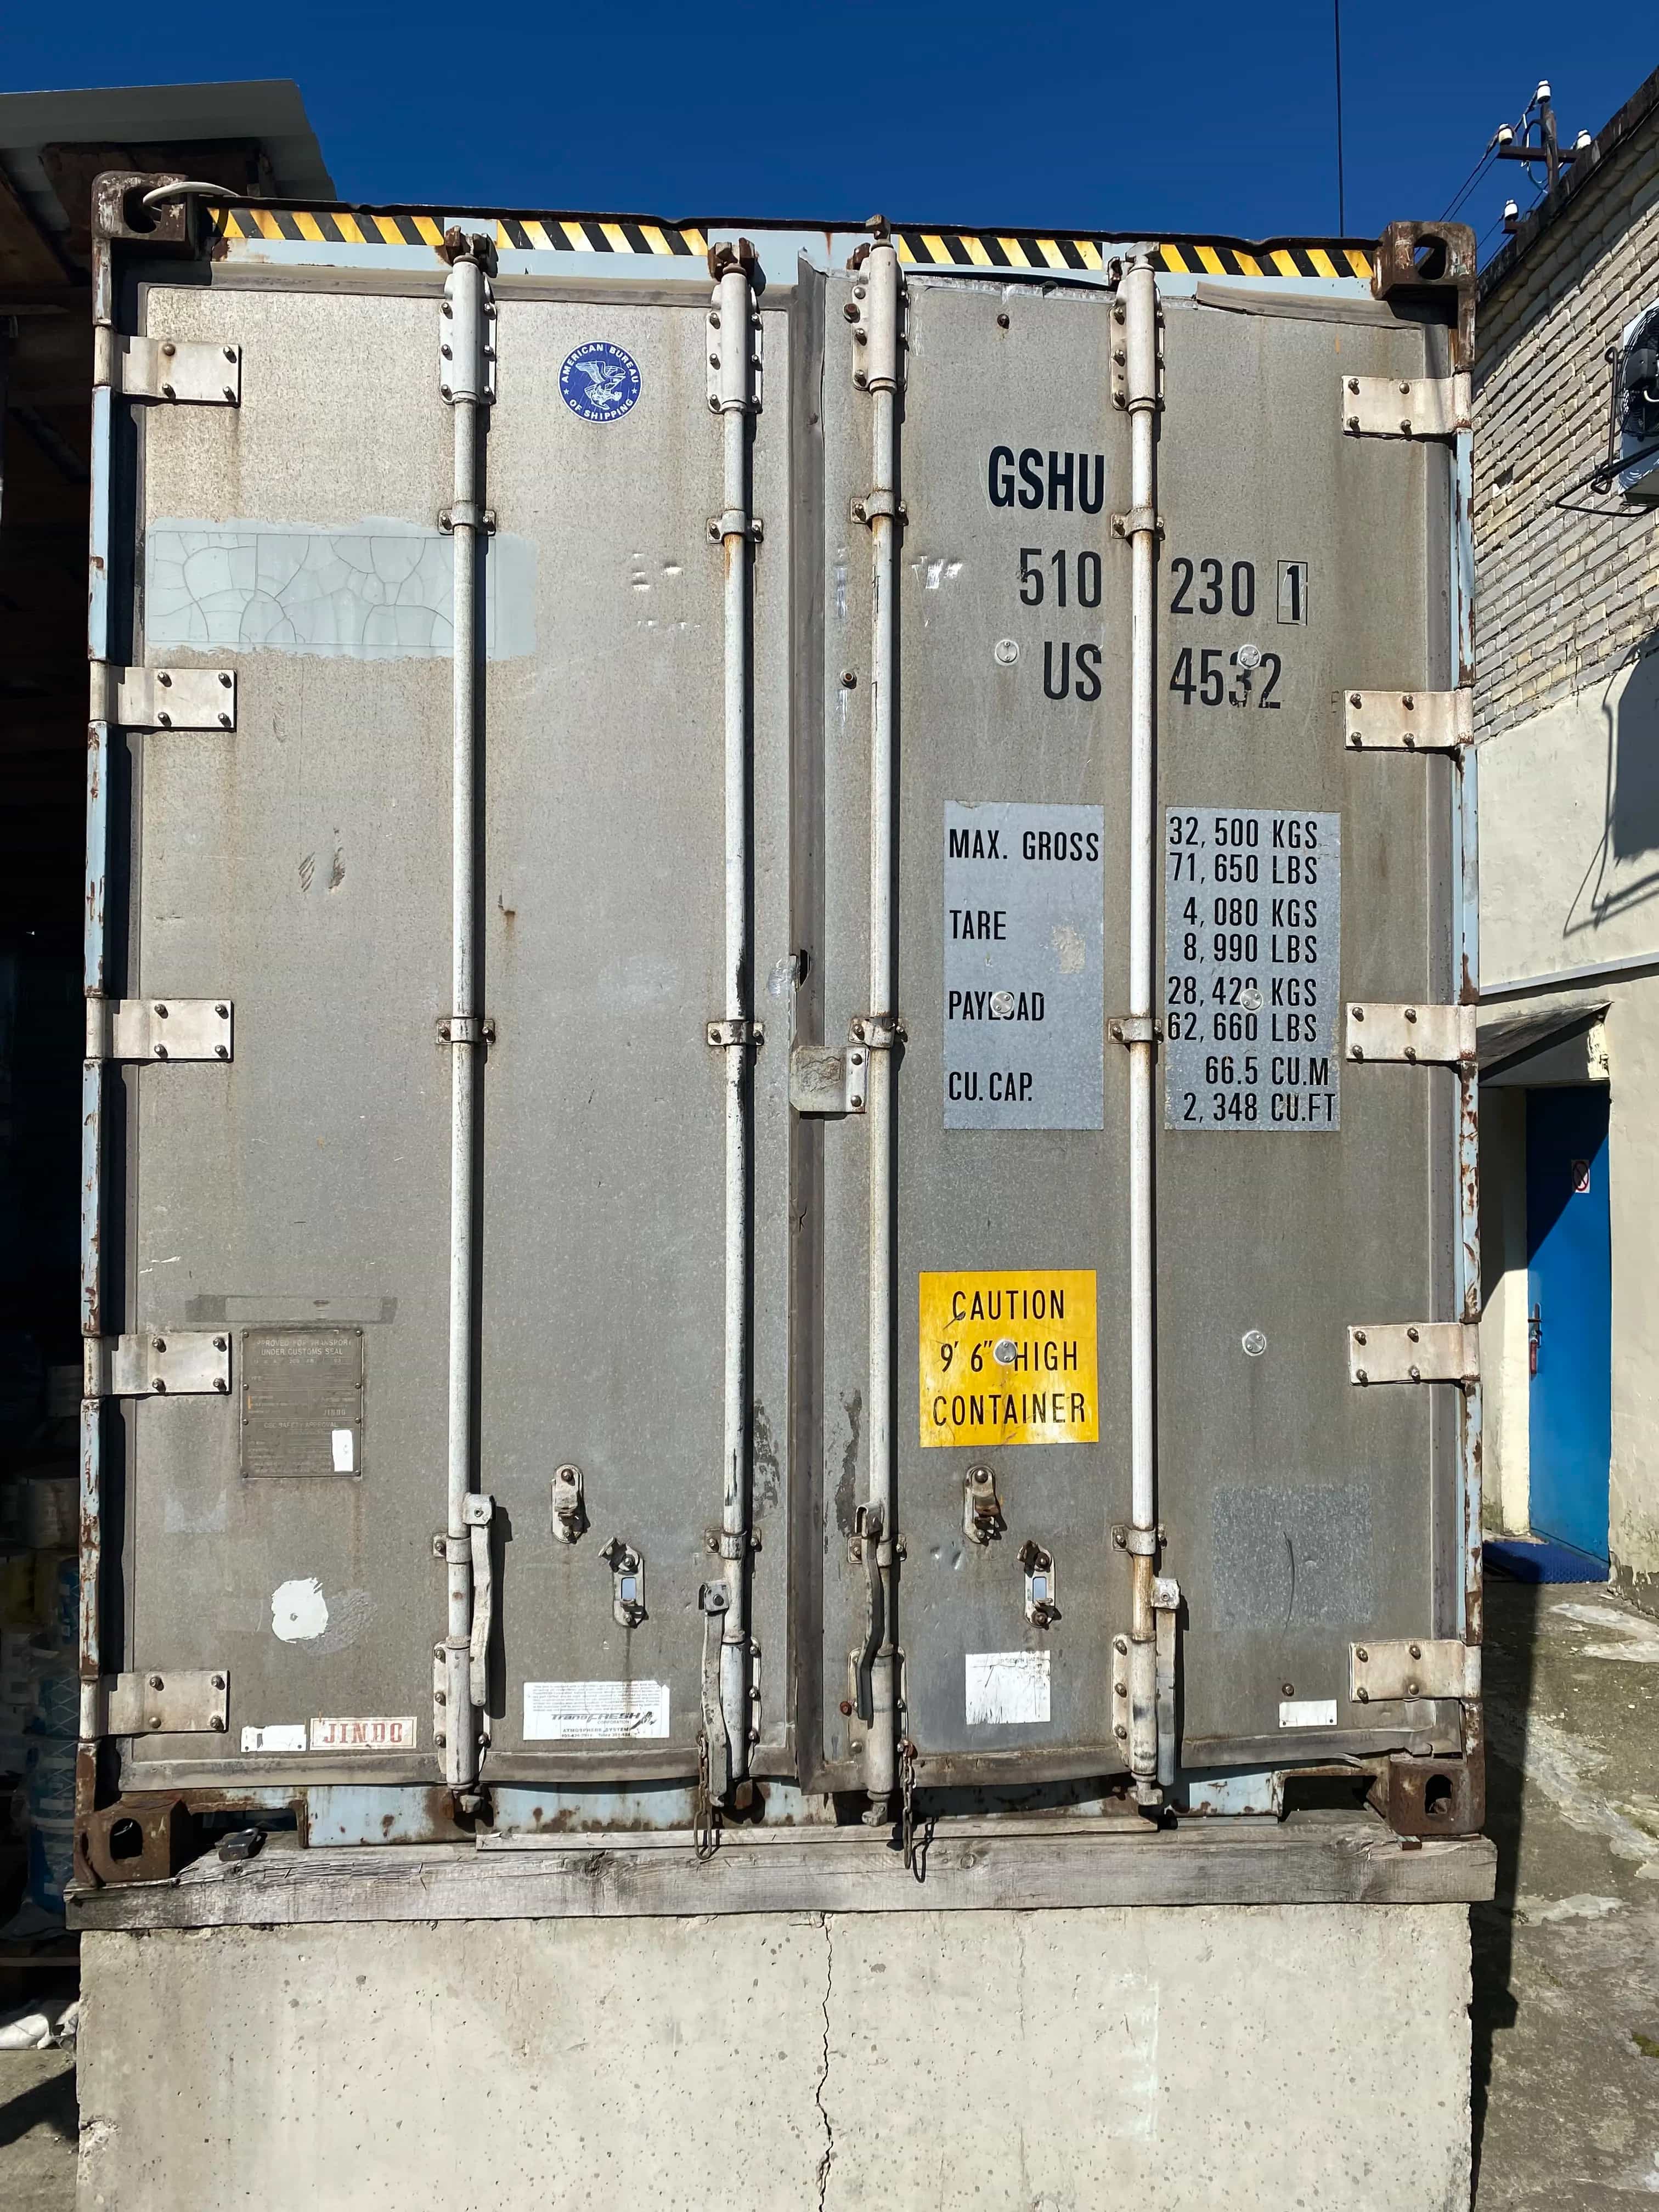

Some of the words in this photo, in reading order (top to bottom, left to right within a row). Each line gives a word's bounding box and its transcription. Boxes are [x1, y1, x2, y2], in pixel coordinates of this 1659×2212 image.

[561, 344, 603, 383] AMERICAN
[609, 346, 639, 383] BUREAU
[569, 399, 583, 413] OF
[583, 398, 634, 420] SHIPPING
[988, 445, 1104, 515] GSHU
[1020, 548, 1102, 608] 510
[1170, 557, 1255, 617] 230
[1285, 565, 1301, 621] 1
[1043, 641, 1102, 702] US
[950, 828, 1007, 859] MAX.
[1023, 831, 1099, 861] GROSS
[1273, 820, 1318, 849] KGS
[1272, 855, 1318, 884] LBS
[949, 910, 1006, 940] TARE
[1272, 899, 1318, 928] KGS
[1272, 934, 1318, 963] LBS
[1272, 978, 1317, 1007] KGS
[1272, 1013, 1317, 1042] LBS
[1206, 1056, 1257, 1085] 66.5
[1272, 1057, 1329, 1086] CU.M
[1271, 1093, 1336, 1122] CU.FT
[952, 1290, 1064, 1321] CAUTION
[261, 1348, 285, 1356] UNDER
[287, 1347, 322, 1356] CUSTOMS
[1014, 1341, 1077, 1372] HIGH
[933, 1393, 1085, 1426] CONTAINER
[324, 1722, 403, 1744] JINDO
